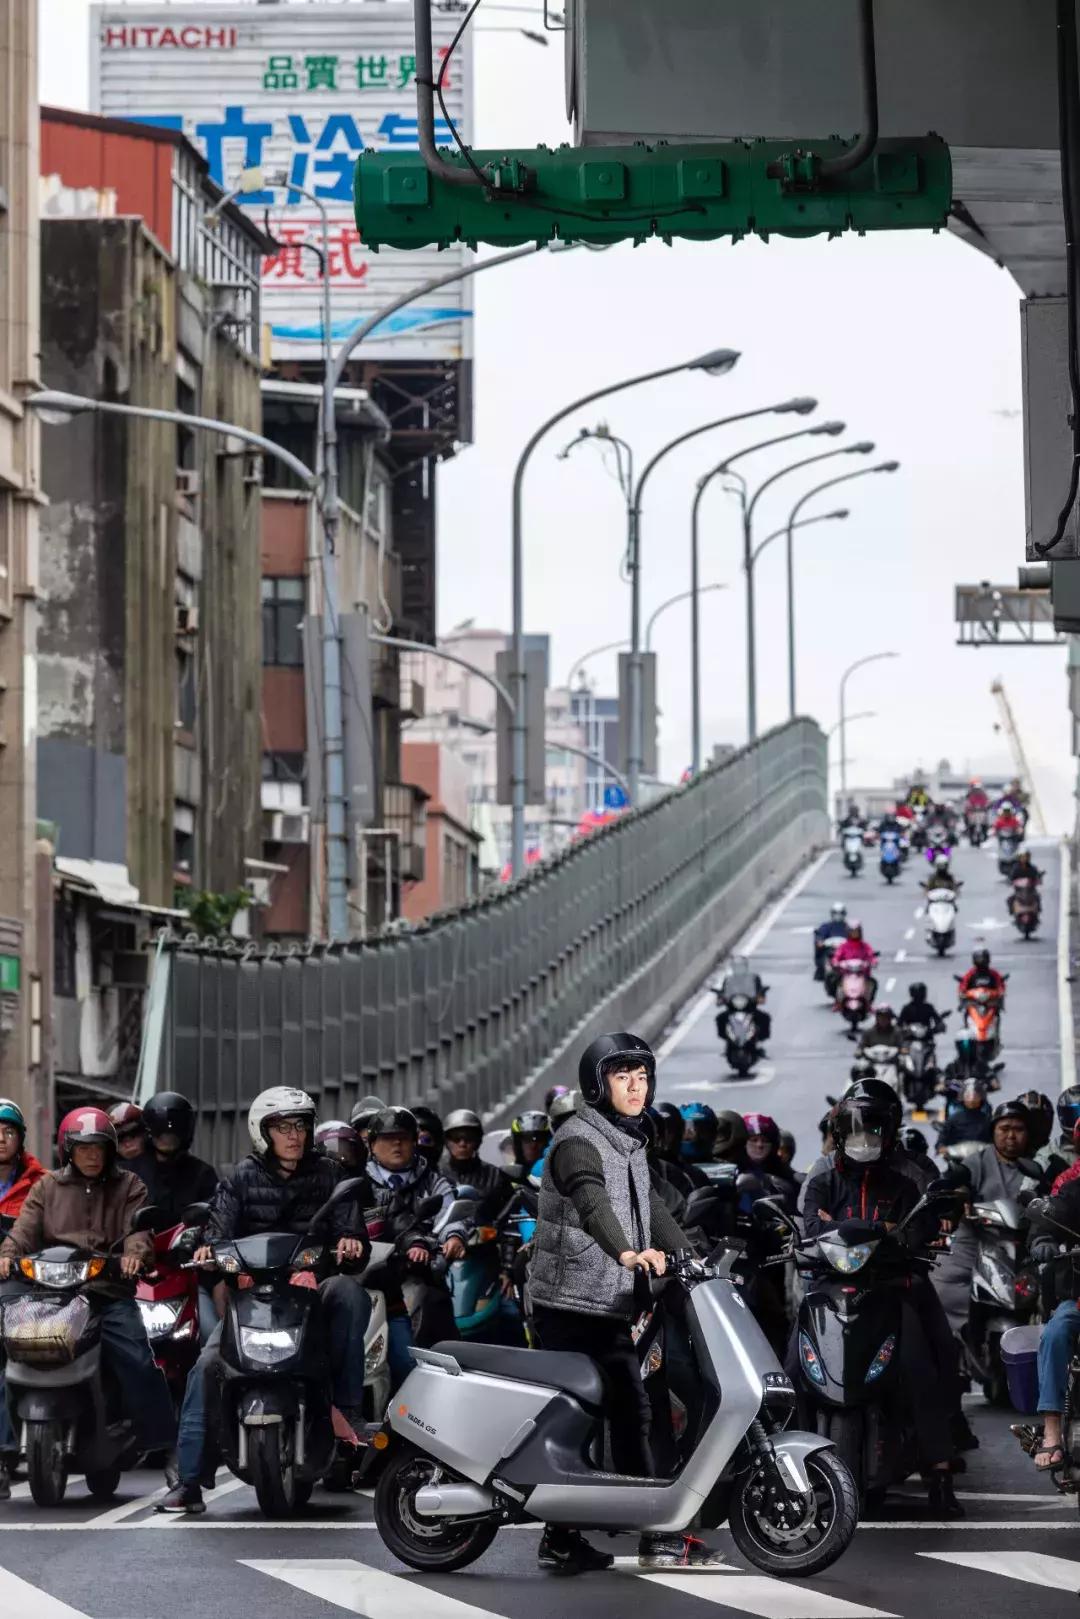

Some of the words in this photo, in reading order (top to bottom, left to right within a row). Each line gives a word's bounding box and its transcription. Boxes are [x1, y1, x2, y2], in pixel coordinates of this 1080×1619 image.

[106, 26, 237, 48] HITACHI
[263, 55, 339, 90] 品質
[106, 106, 457, 205] 立冷
[76, 1113, 96, 1136] 1
[425, 1425, 436, 1434] GS
